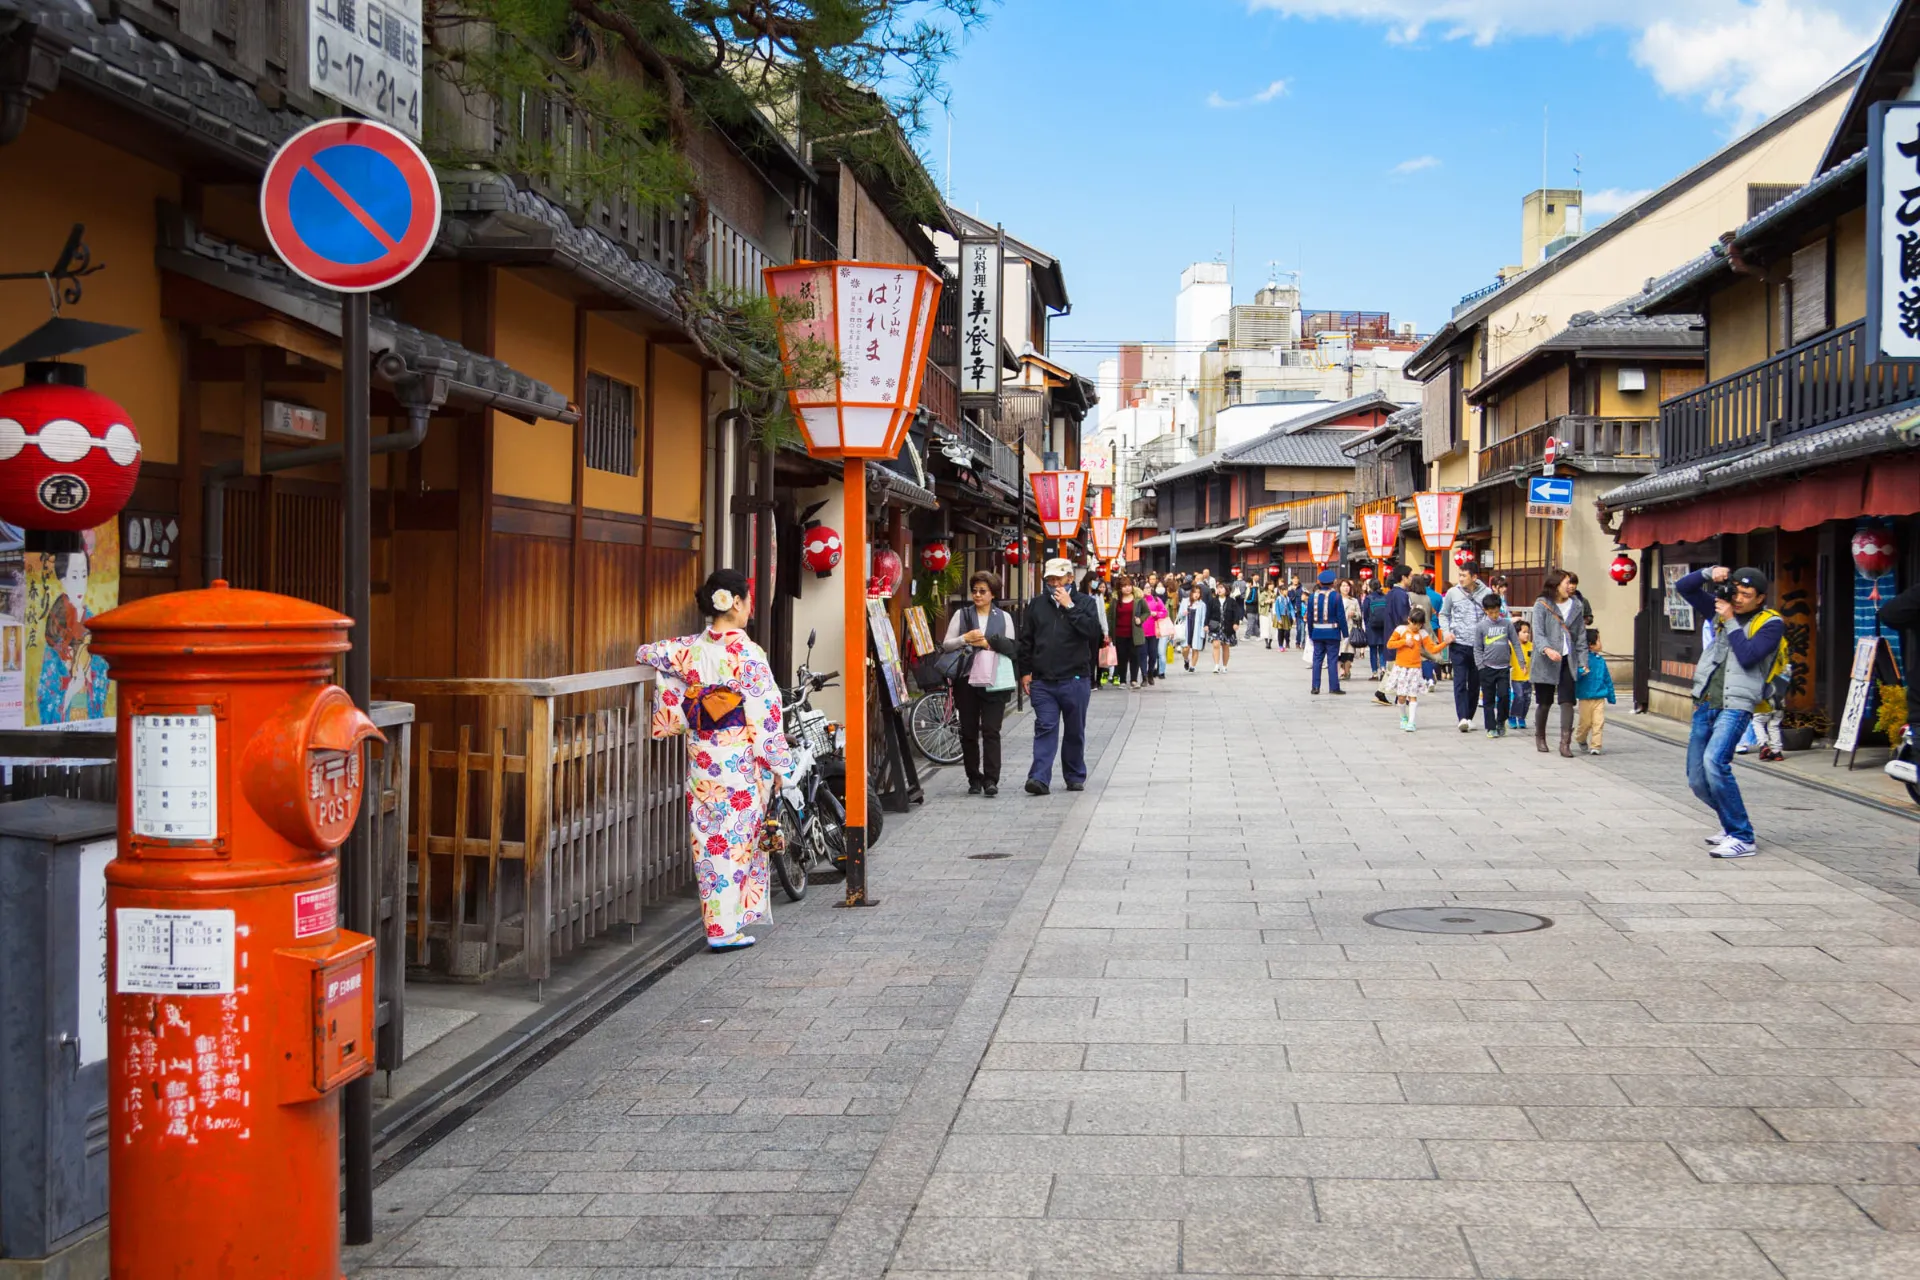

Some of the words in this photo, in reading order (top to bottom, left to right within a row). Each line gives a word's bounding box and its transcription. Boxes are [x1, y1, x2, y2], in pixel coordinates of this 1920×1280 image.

[972, 246, 987, 288] 京料理
[865, 282, 888, 361] はれま
[888, 273, 904, 338] チリメン山椒
[1487, 626, 1507, 637] NIKE
[319, 793, 354, 827] POST
